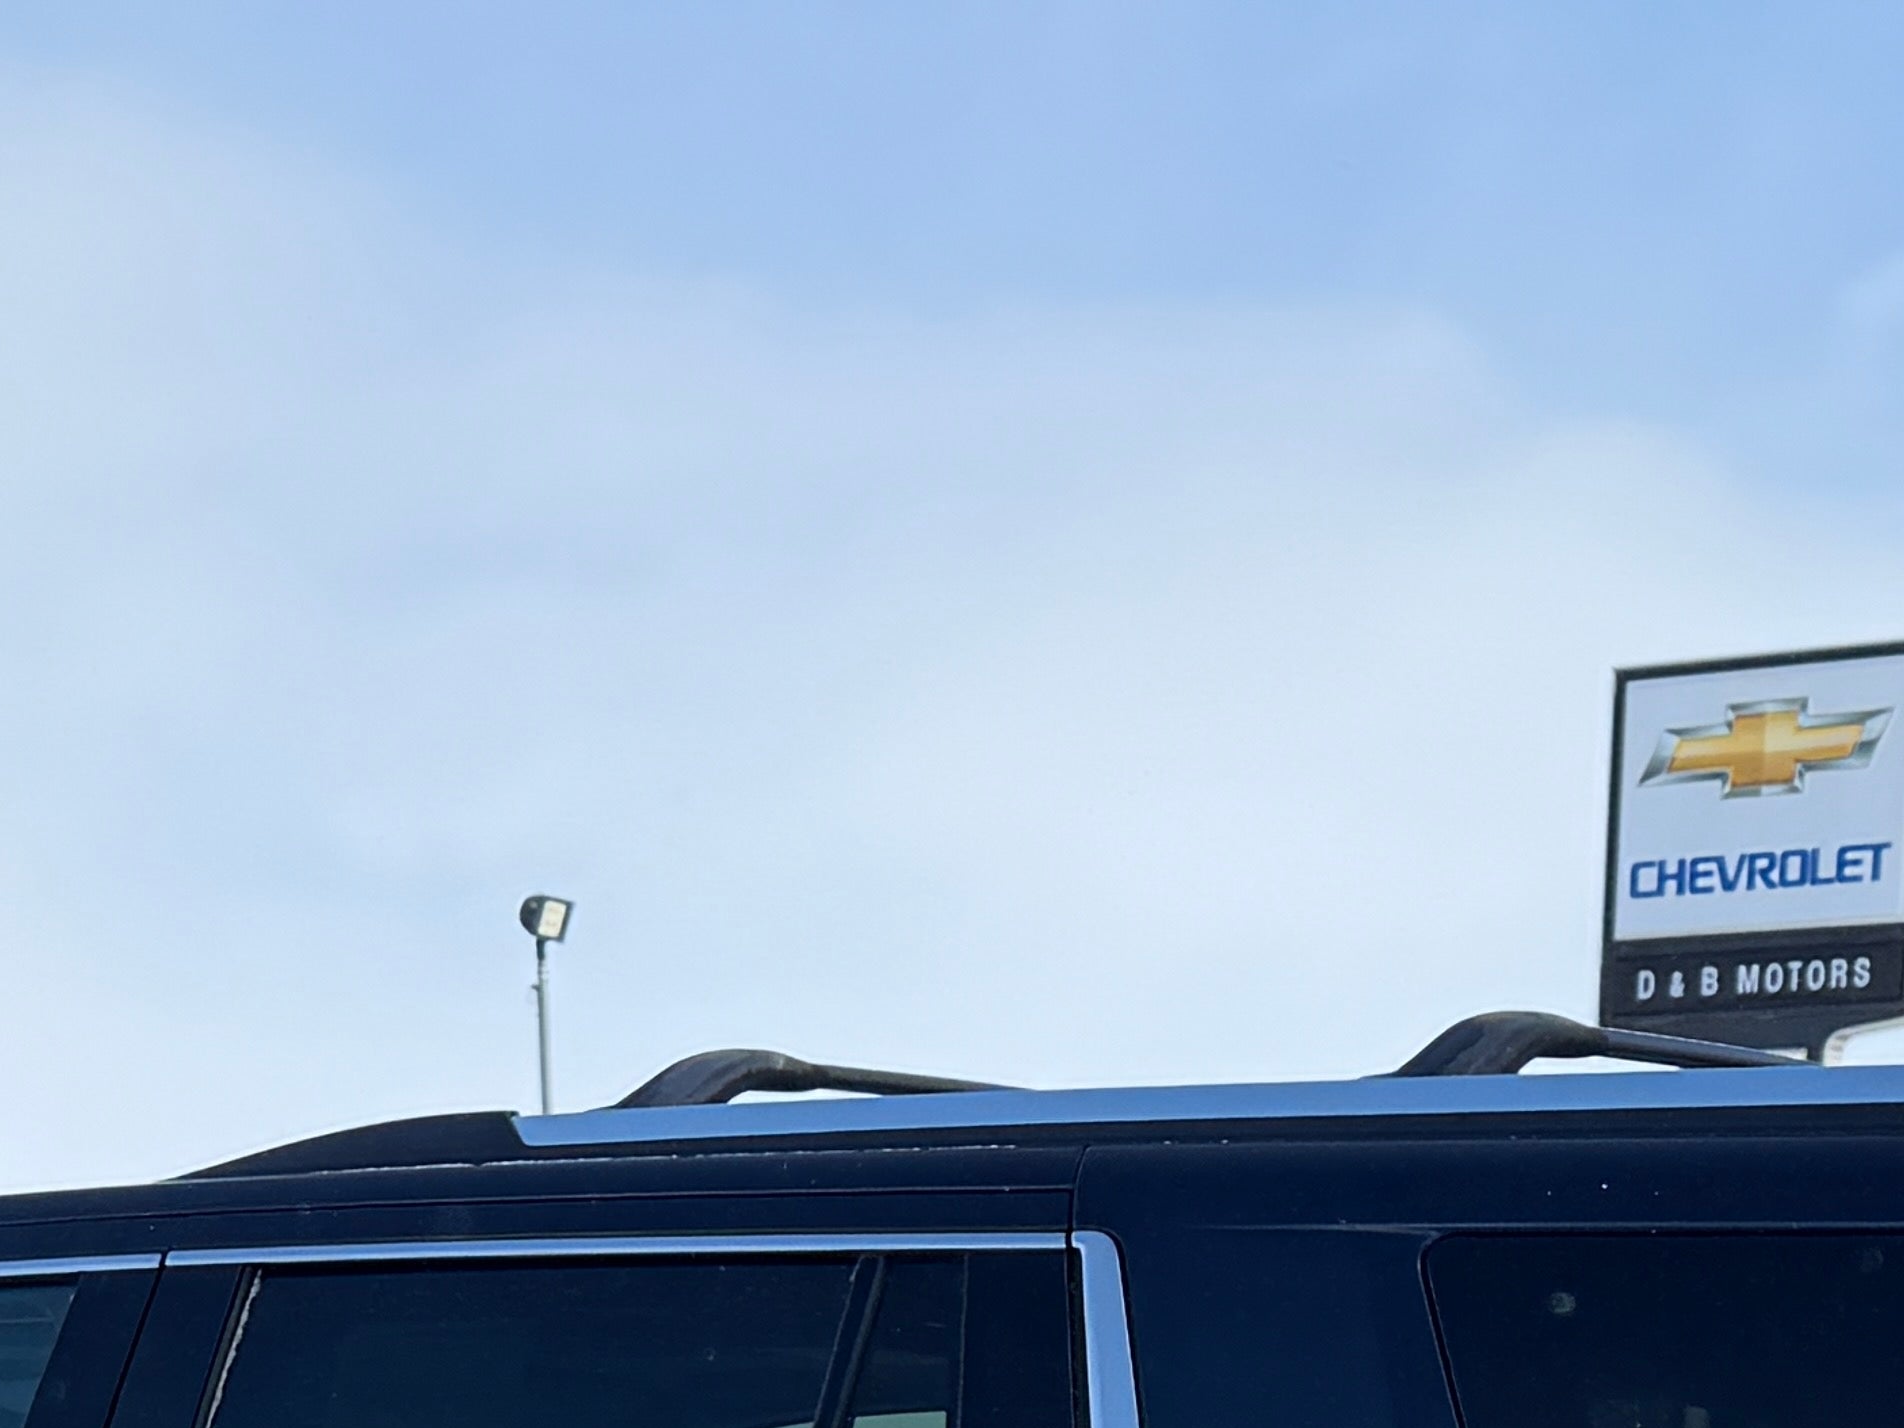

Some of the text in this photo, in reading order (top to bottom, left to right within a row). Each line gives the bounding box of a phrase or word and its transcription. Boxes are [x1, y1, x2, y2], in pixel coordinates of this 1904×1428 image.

[1629, 843, 1892, 898] CHEVROLET
[1637, 957, 1872, 1000] D & B MOTORS
